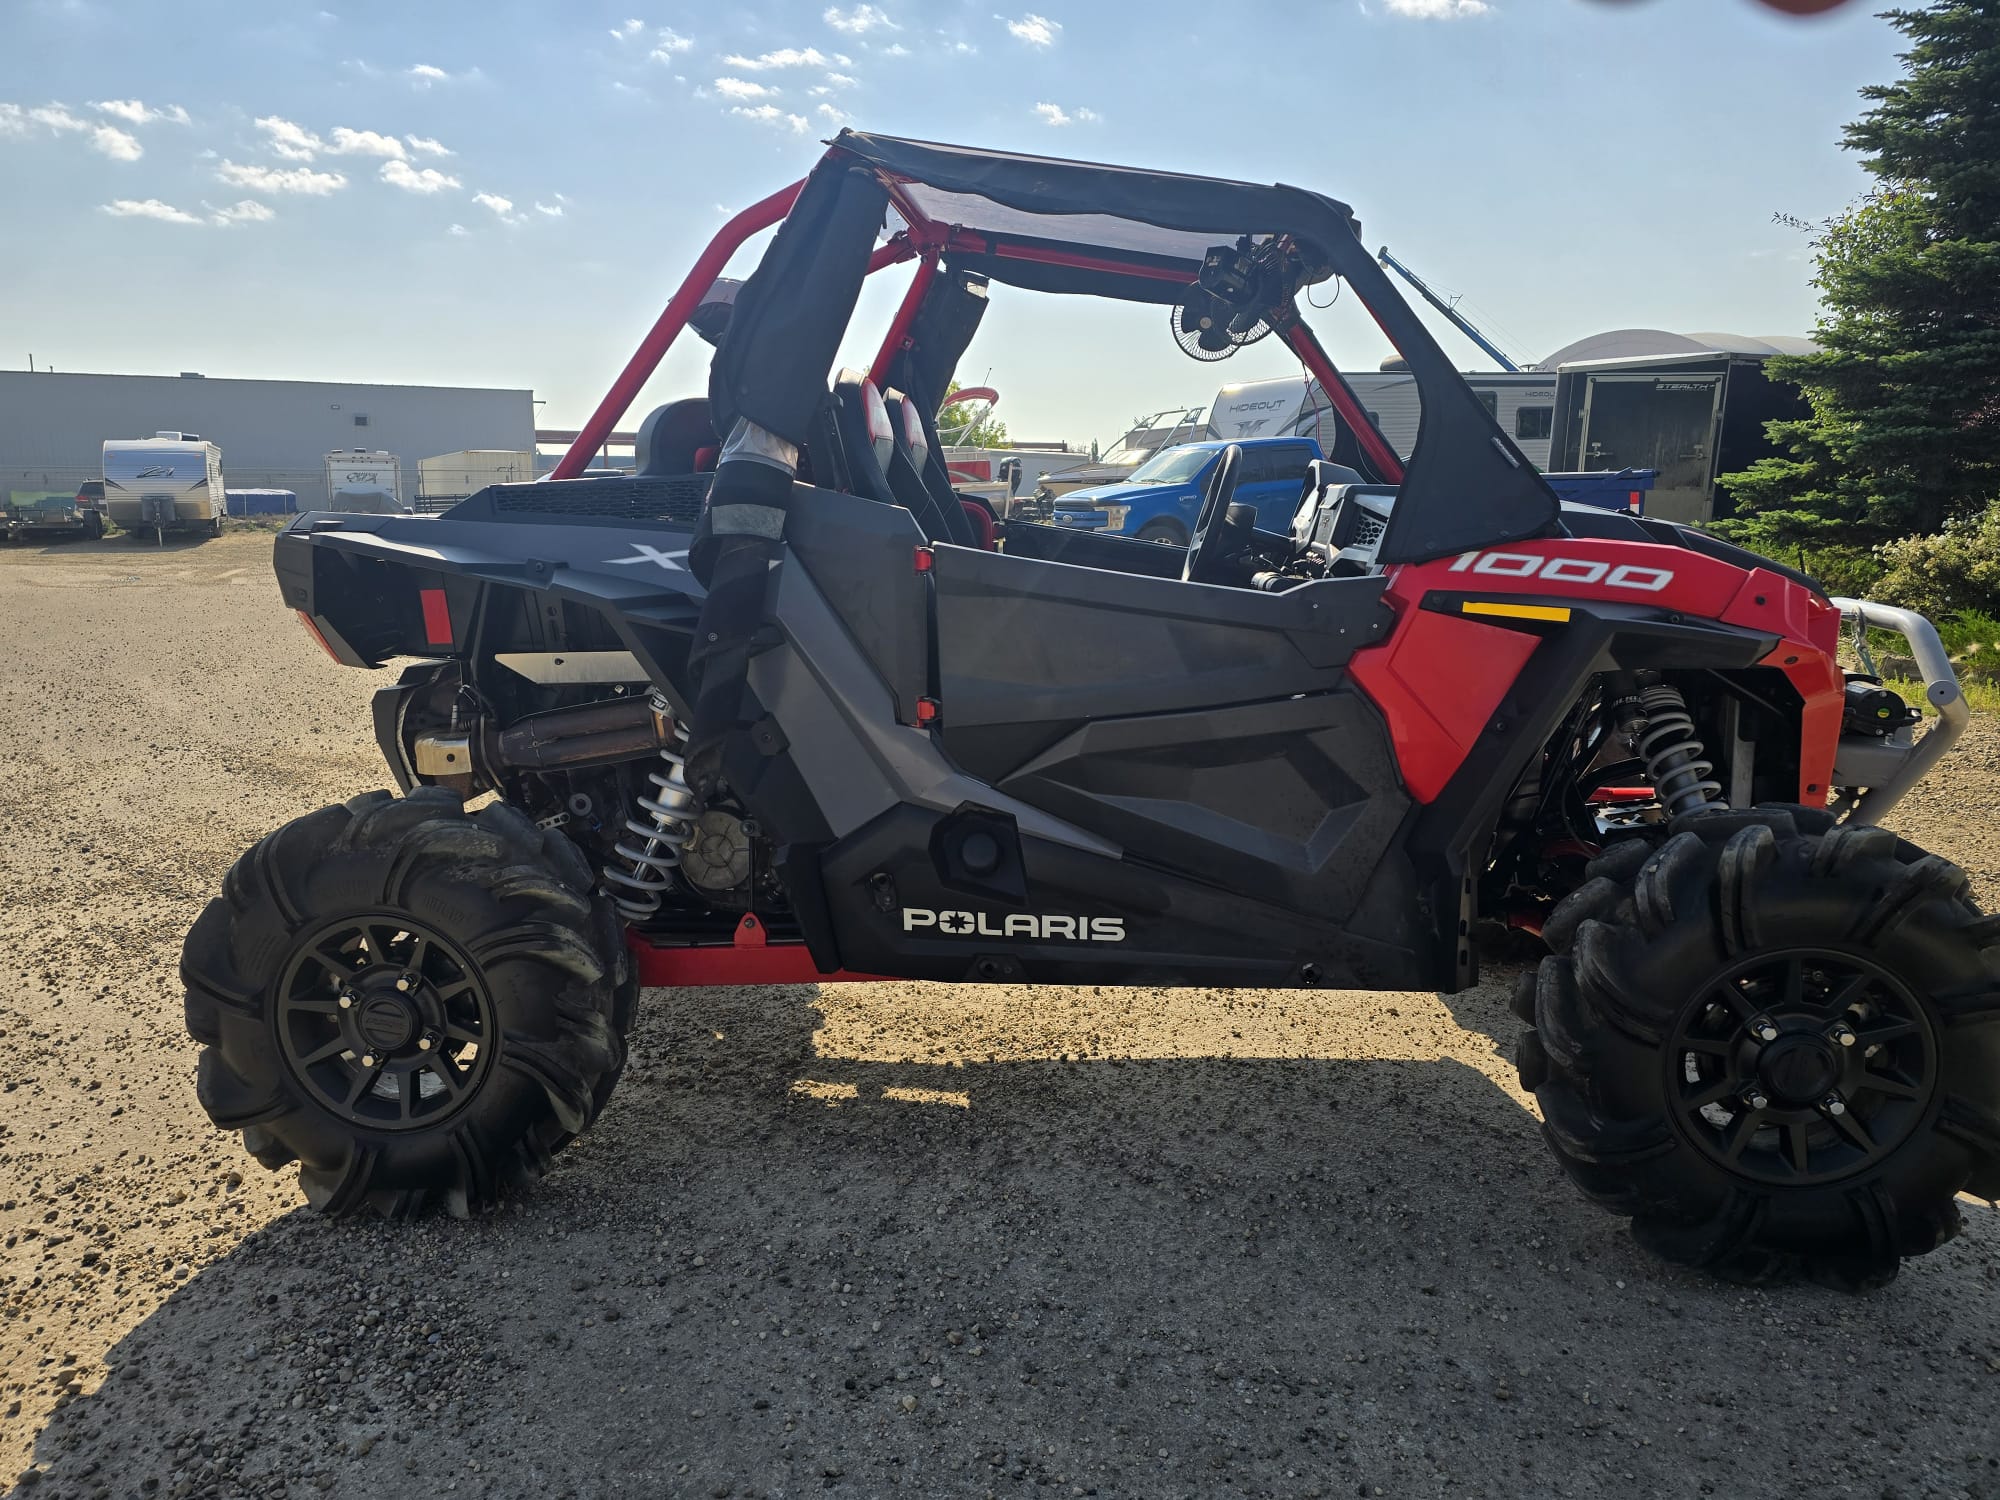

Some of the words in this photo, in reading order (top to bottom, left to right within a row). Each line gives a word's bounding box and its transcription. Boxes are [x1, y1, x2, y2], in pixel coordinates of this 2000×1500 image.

[1229, 400, 1286, 413] HIDEOUT
[1448, 551, 1675, 592] 1000
[902, 907, 1127, 942] POLARIS
